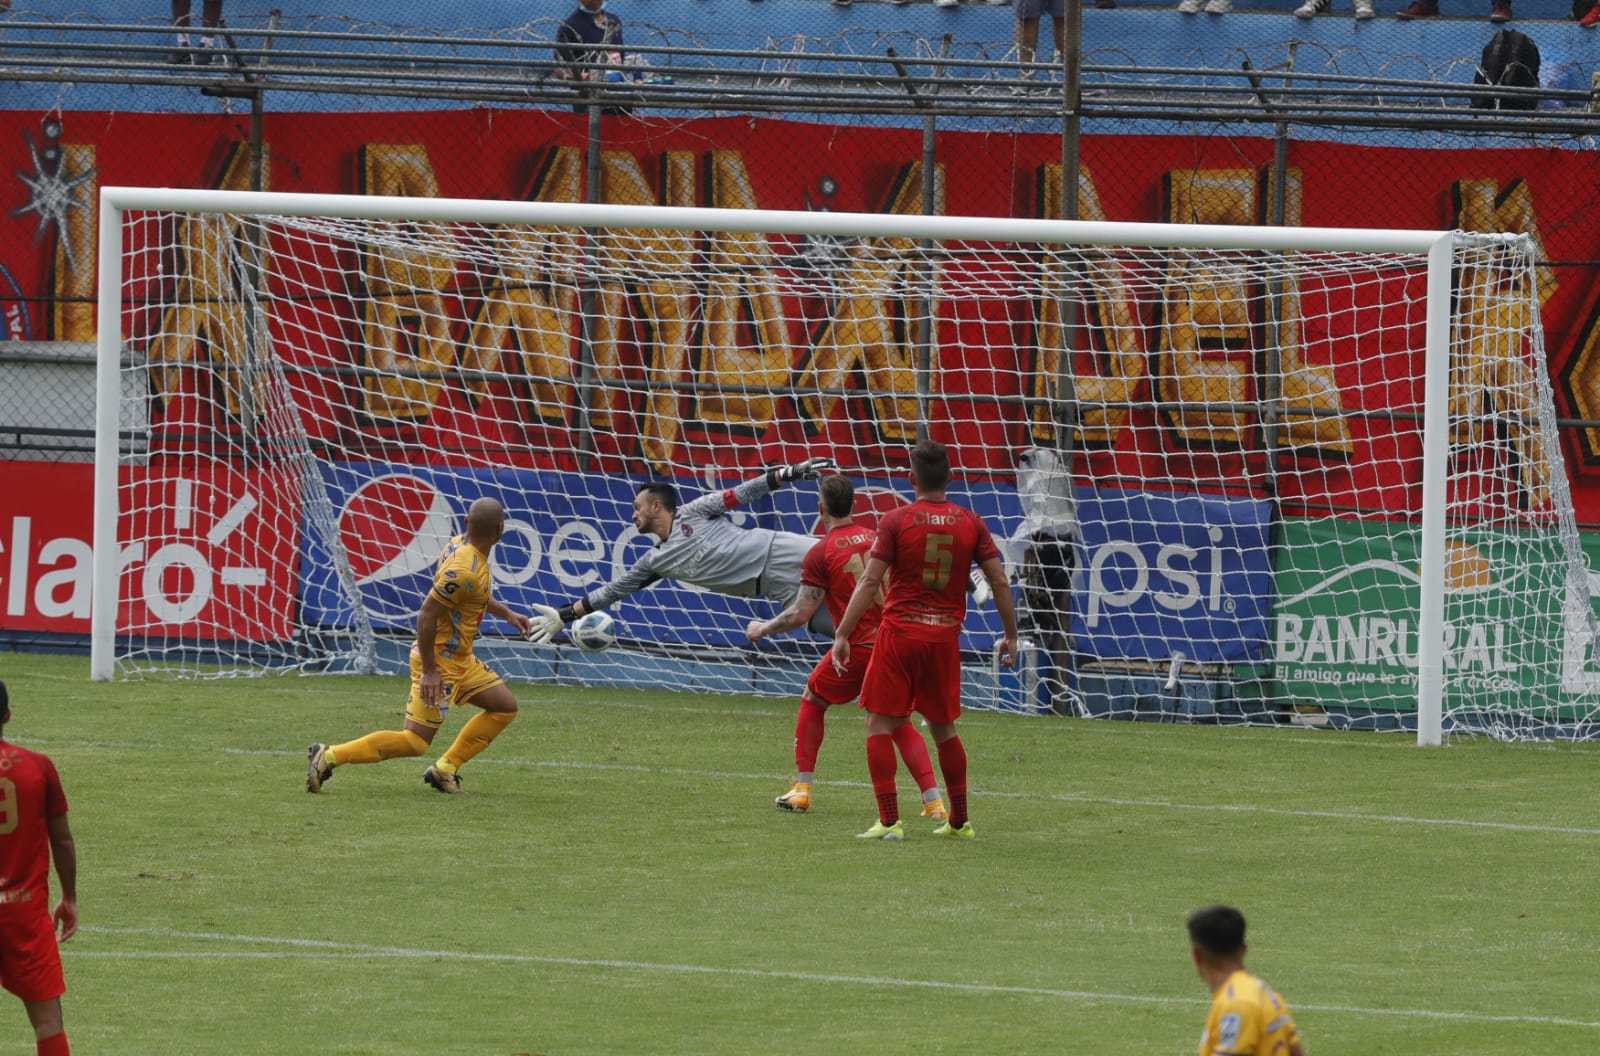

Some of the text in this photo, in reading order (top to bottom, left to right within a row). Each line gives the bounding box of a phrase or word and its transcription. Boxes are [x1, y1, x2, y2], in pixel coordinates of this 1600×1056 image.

[1033, 162, 1353, 455] DEL
[922, 532, 954, 591] 5
[1275, 665, 1289, 680] El
[1293, 667, 1342, 685] amigo
[1346, 671, 1376, 686] que
